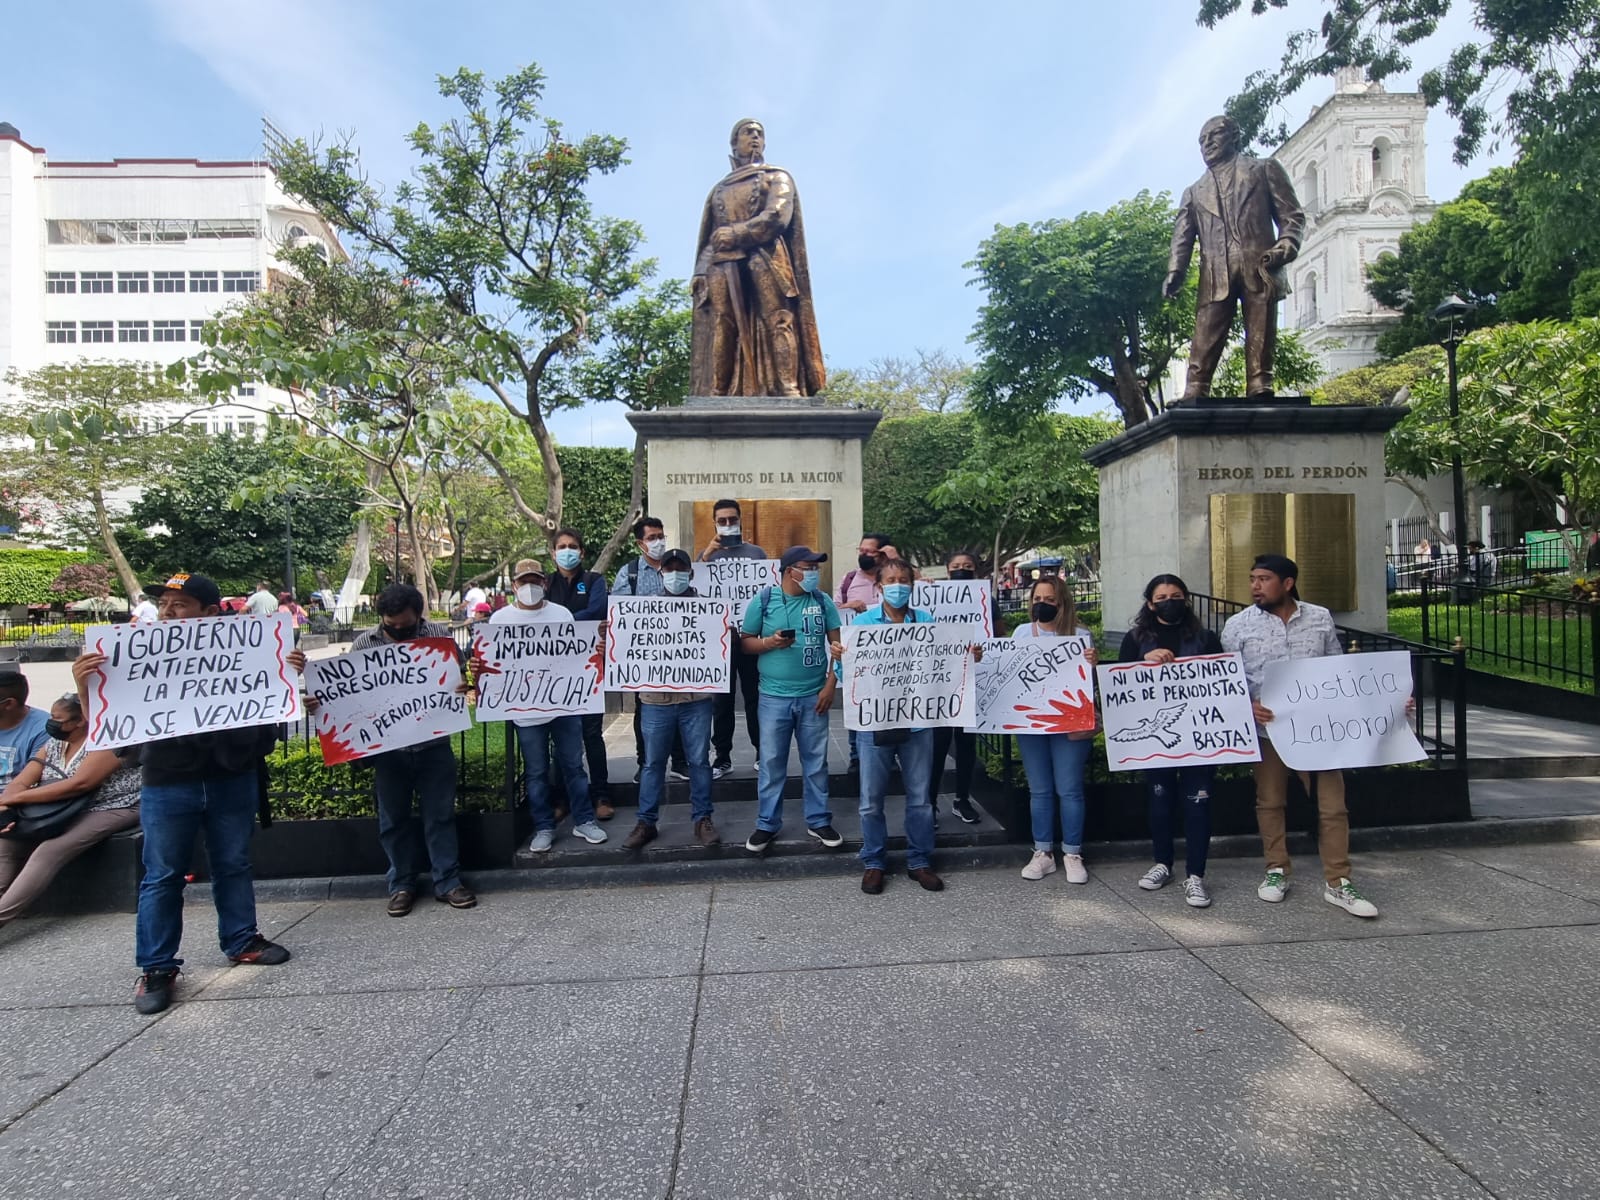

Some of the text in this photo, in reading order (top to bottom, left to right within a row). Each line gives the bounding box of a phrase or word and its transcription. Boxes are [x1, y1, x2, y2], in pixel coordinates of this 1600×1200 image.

[666, 471, 843, 485] SENTIMIENTOS DE LA NACION
[1197, 462, 1368, 480] HÉROE DEL PERDÓN
[706, 563, 768, 585] RESPETO
[911, 584, 972, 607] USTICIA
[618, 600, 725, 615] ESCLARECIMIENTO
[929, 607, 937, 617] Y
[493, 623, 575, 642] ¡ALTO A LA
[617, 616, 698, 630] A CASOS DE
[802, 615, 825, 635] 19
[112, 620, 263, 667] ¡GOBIERNO
[495, 635, 596, 659] IMPUNIDAD!
[630, 631, 706, 647] PERIODISTAS
[856, 625, 936, 648] EXIGIMOS
[975, 640, 1016, 652] GIMOS
[626, 647, 706, 661] ASESINADOS
[854, 647, 895, 663] PRONTA
[127, 651, 245, 681] ENTIENDE
[314, 659, 355, 684] ¡NO
[609, 662, 727, 687] ¡NO IMPUNIDAD!
[854, 666, 867, 678] DE
[933, 659, 946, 671] DE
[1113, 660, 1238, 686] NI UN ASESINATO
[143, 670, 269, 702] LA PRENSA
[314, 667, 428, 706] AGRESIONES
[479, 668, 597, 709] ¡JUSTICIA!
[903, 686, 916, 696] EN
[1106, 679, 1246, 708] MAS DE PERIODISTAS
[1286, 667, 1401, 704] Justicia
[95, 689, 290, 745] NO SE VENDE!
[359, 691, 465, 744] A PERIODISTAS!
[859, 693, 961, 726] GUERRERO
[1190, 706, 1225, 726] ¡YA
[1192, 722, 1252, 751] BASTA!
[1290, 704, 1395, 746] Laboral
